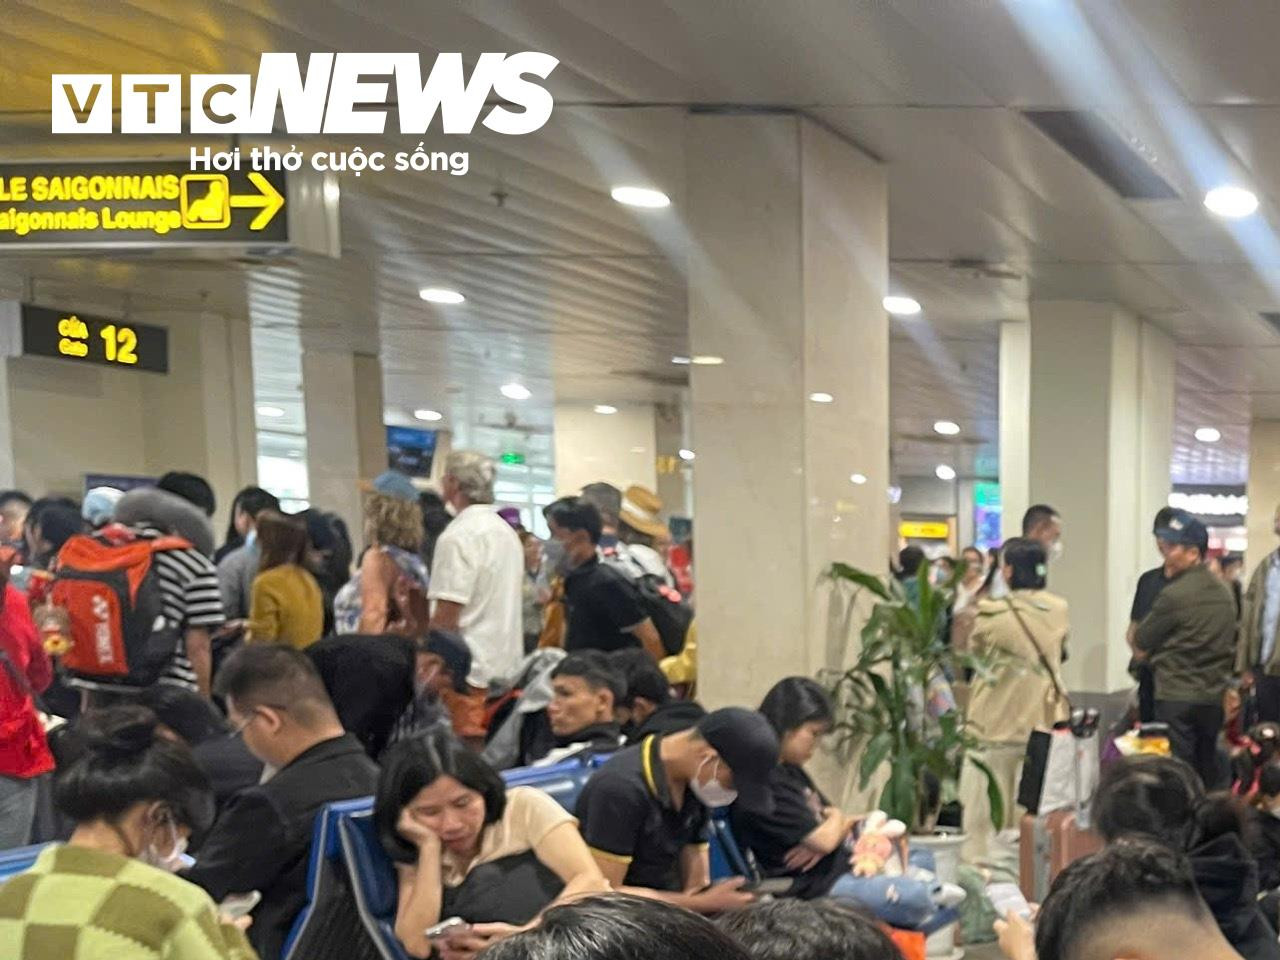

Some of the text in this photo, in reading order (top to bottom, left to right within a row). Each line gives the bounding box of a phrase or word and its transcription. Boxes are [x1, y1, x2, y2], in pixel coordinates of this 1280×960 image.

[31, 174, 180, 201] SAIGONNAIS
[101, 207, 182, 234] Lounge
[100, 325, 138, 364] 12
